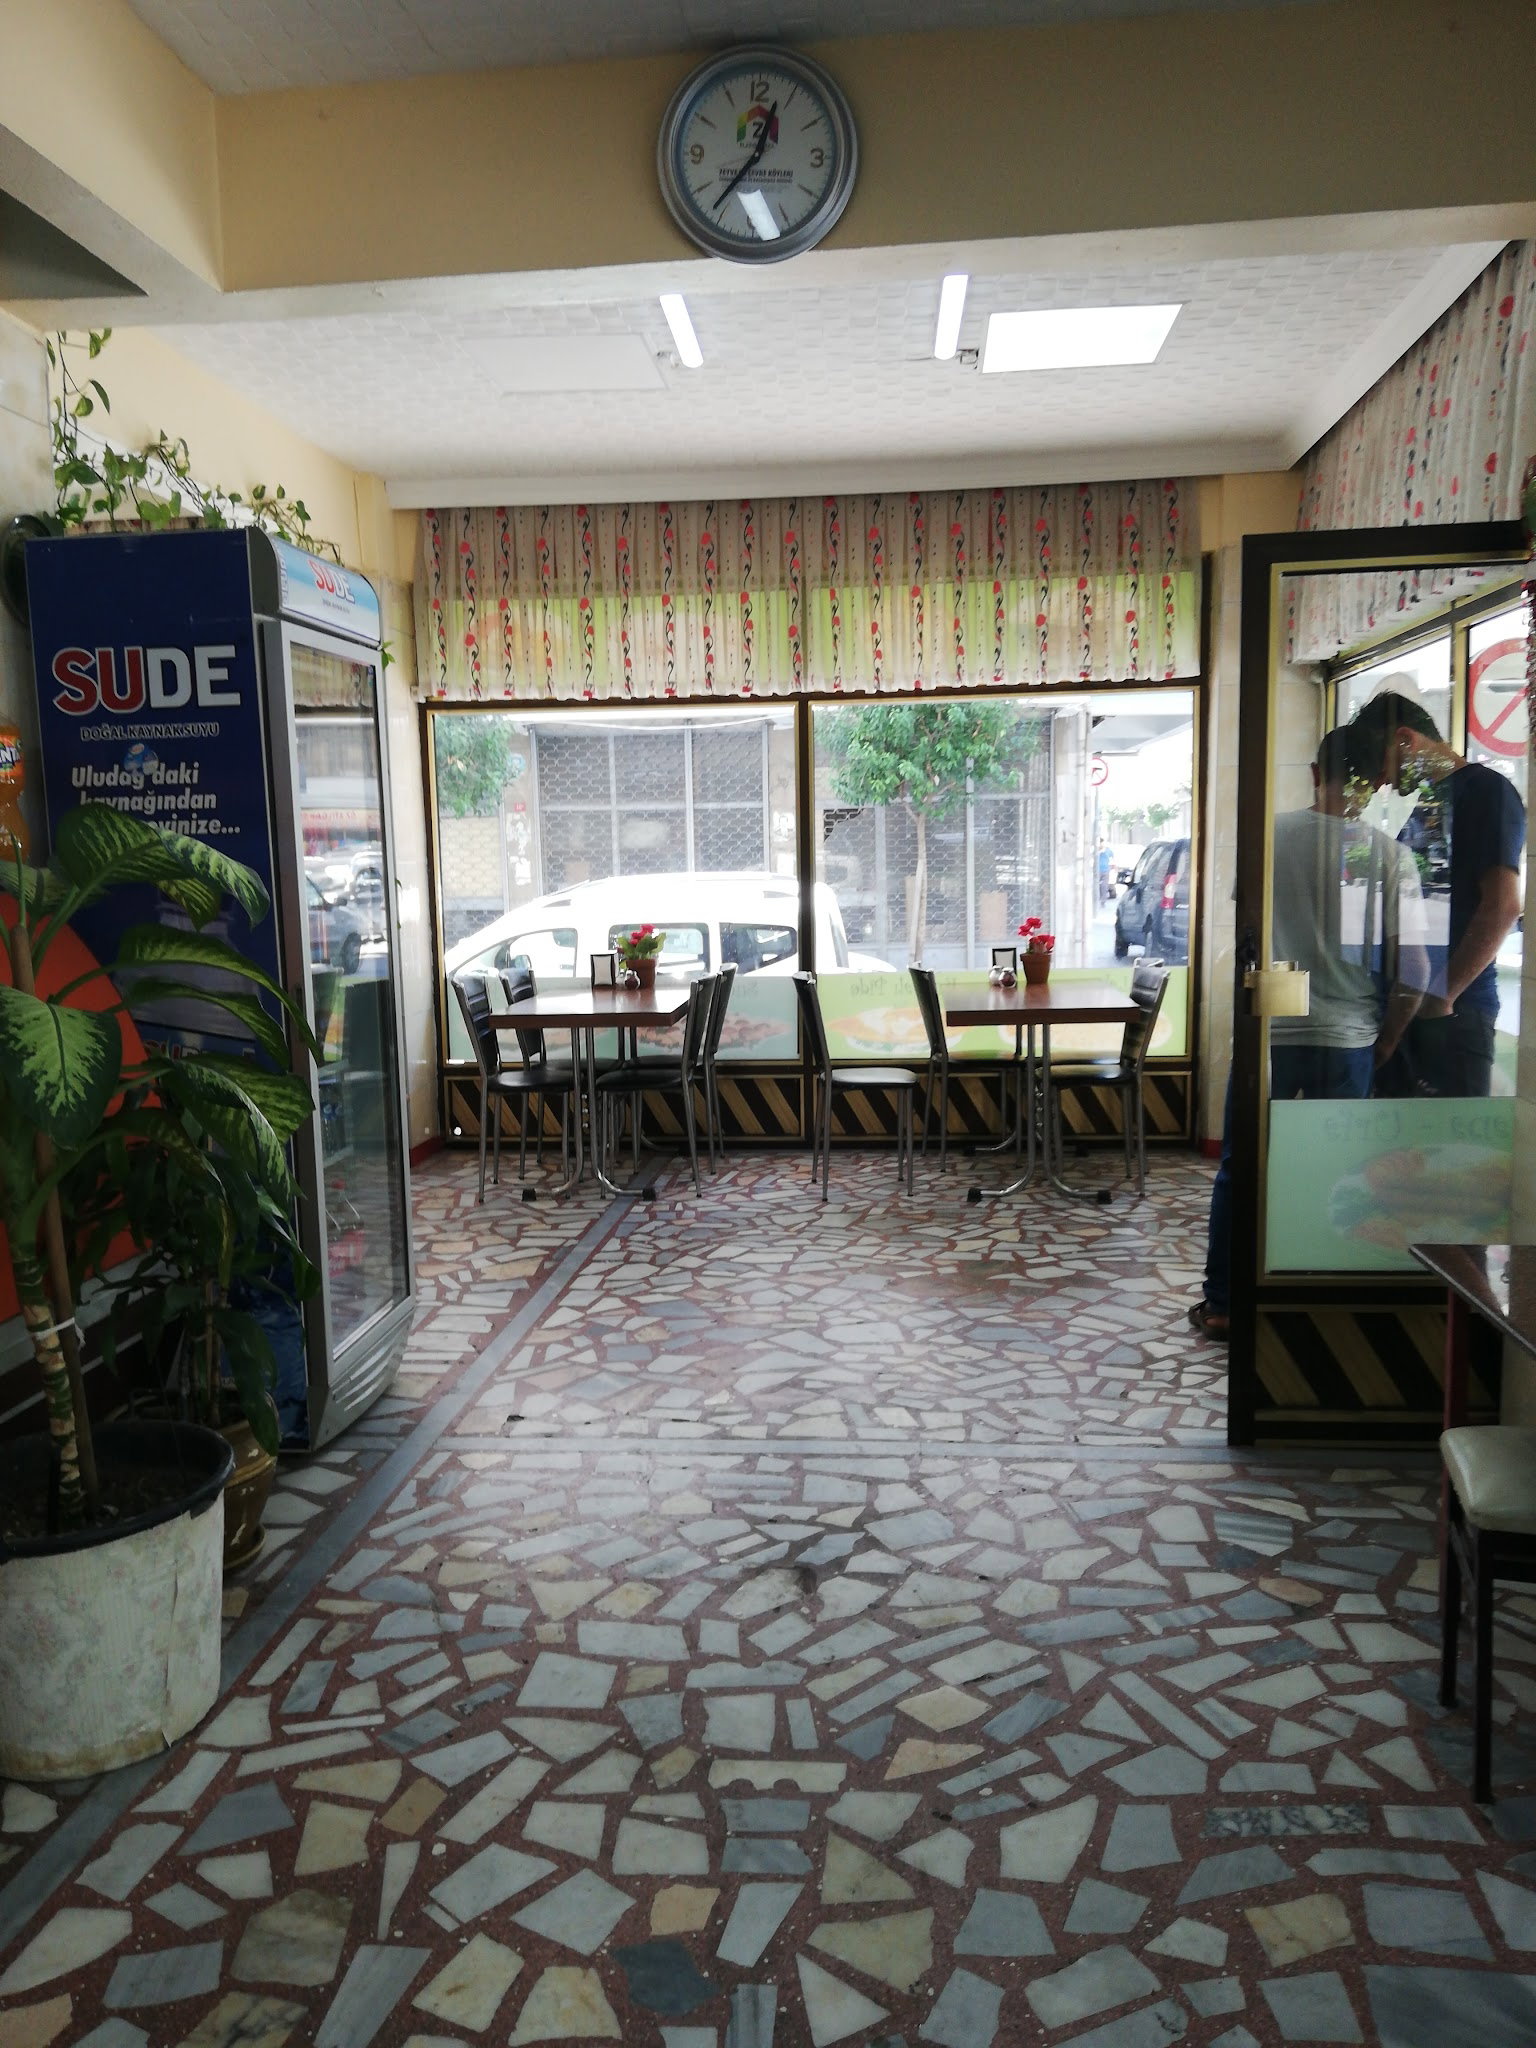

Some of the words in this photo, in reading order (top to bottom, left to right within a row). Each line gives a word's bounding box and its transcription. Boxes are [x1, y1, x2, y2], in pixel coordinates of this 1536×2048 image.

[750, 81, 770, 102] 12
[689, 145, 705, 164] 9
[810, 148, 824, 168] 3
[307, 558, 356, 604] SUDE
[52, 645, 241, 716] SUDE
[80, 723, 127, 741] DOĞAL
[127, 723, 183, 740] KAYNAK
[183, 722, 219, 738] SUYU
